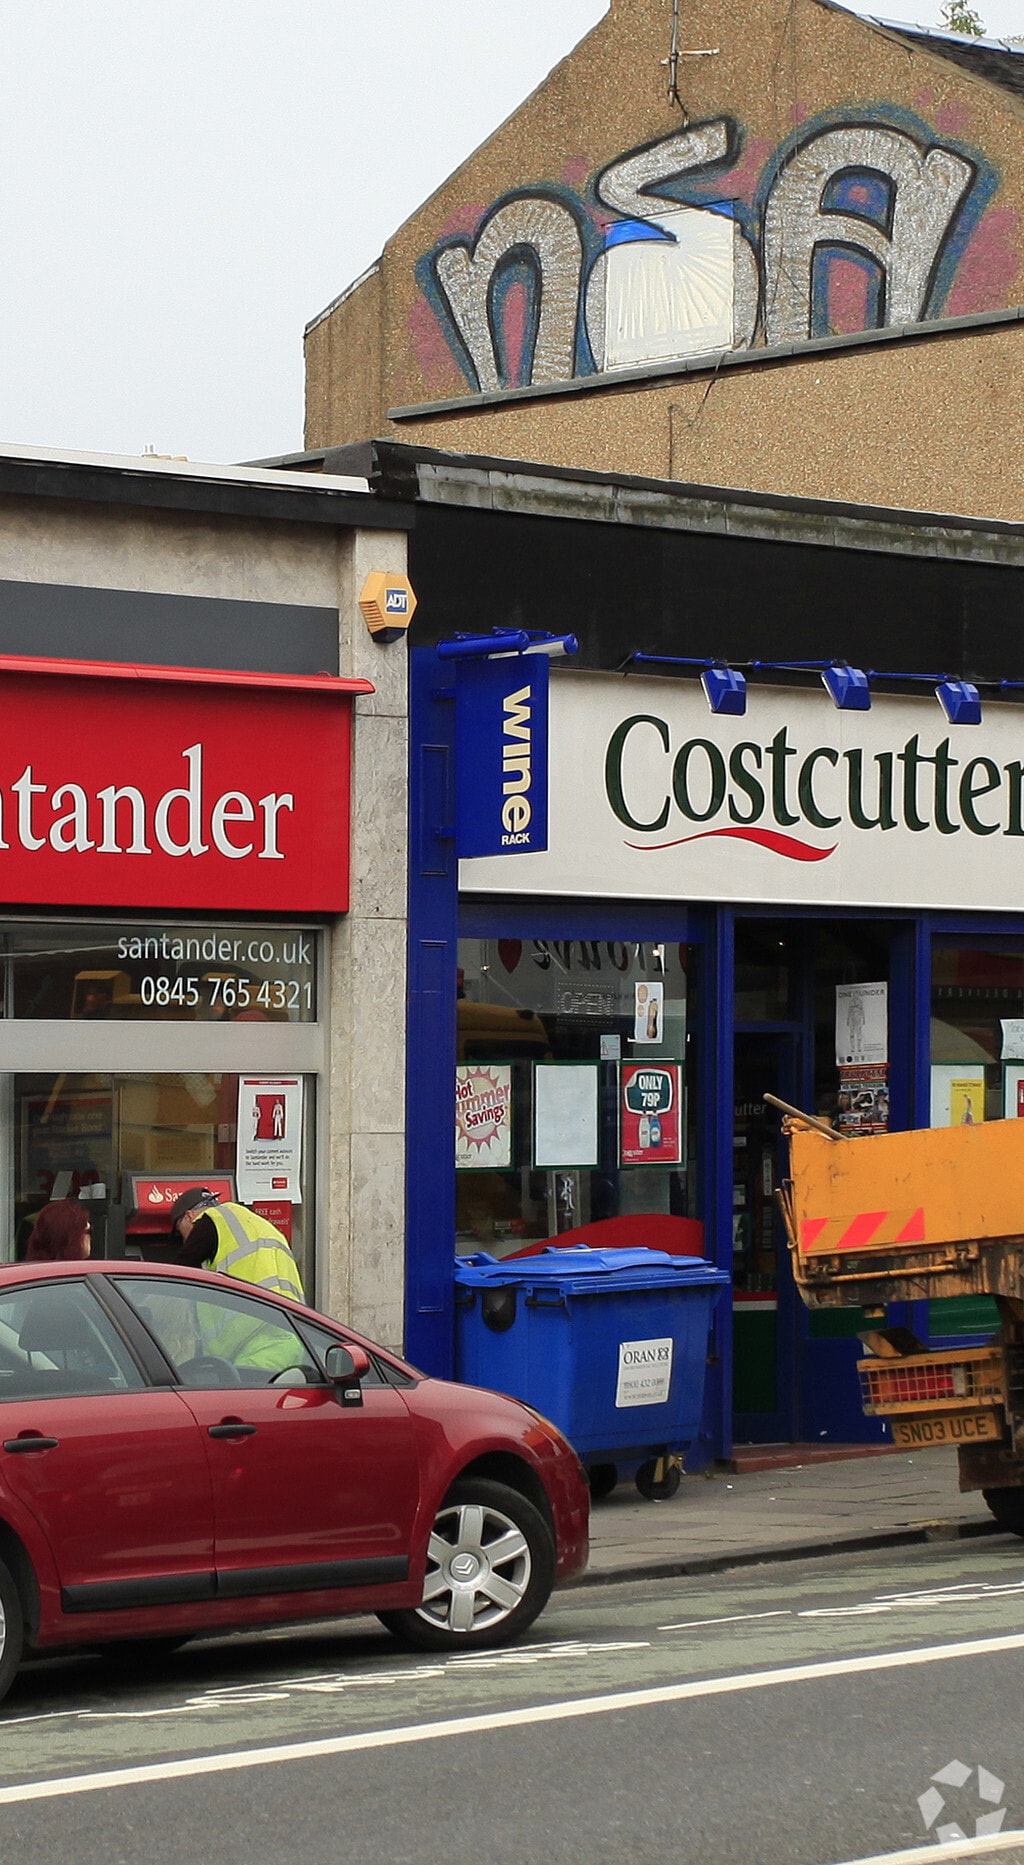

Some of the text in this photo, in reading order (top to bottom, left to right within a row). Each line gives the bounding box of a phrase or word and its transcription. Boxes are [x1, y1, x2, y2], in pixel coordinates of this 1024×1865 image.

[386, 593, 408, 608] ADT
[502, 685, 532, 833] wine
[604, 714, 1024, 837] Costcutter
[501, 832, 531, 846] RACK
[117, 932, 312, 965] santander.co.uk
[140, 976, 313, 1010] 0845 765 4321
[638, 1074, 664, 1091] ONLY
[456, 1083, 511, 1116] ummer
[640, 1092, 661, 1107] 79P
[465, 1104, 506, 1130] Savings
[623, 1349, 656, 1365] ORAN
[899, 1416, 989, 1443] SN03 UCE
